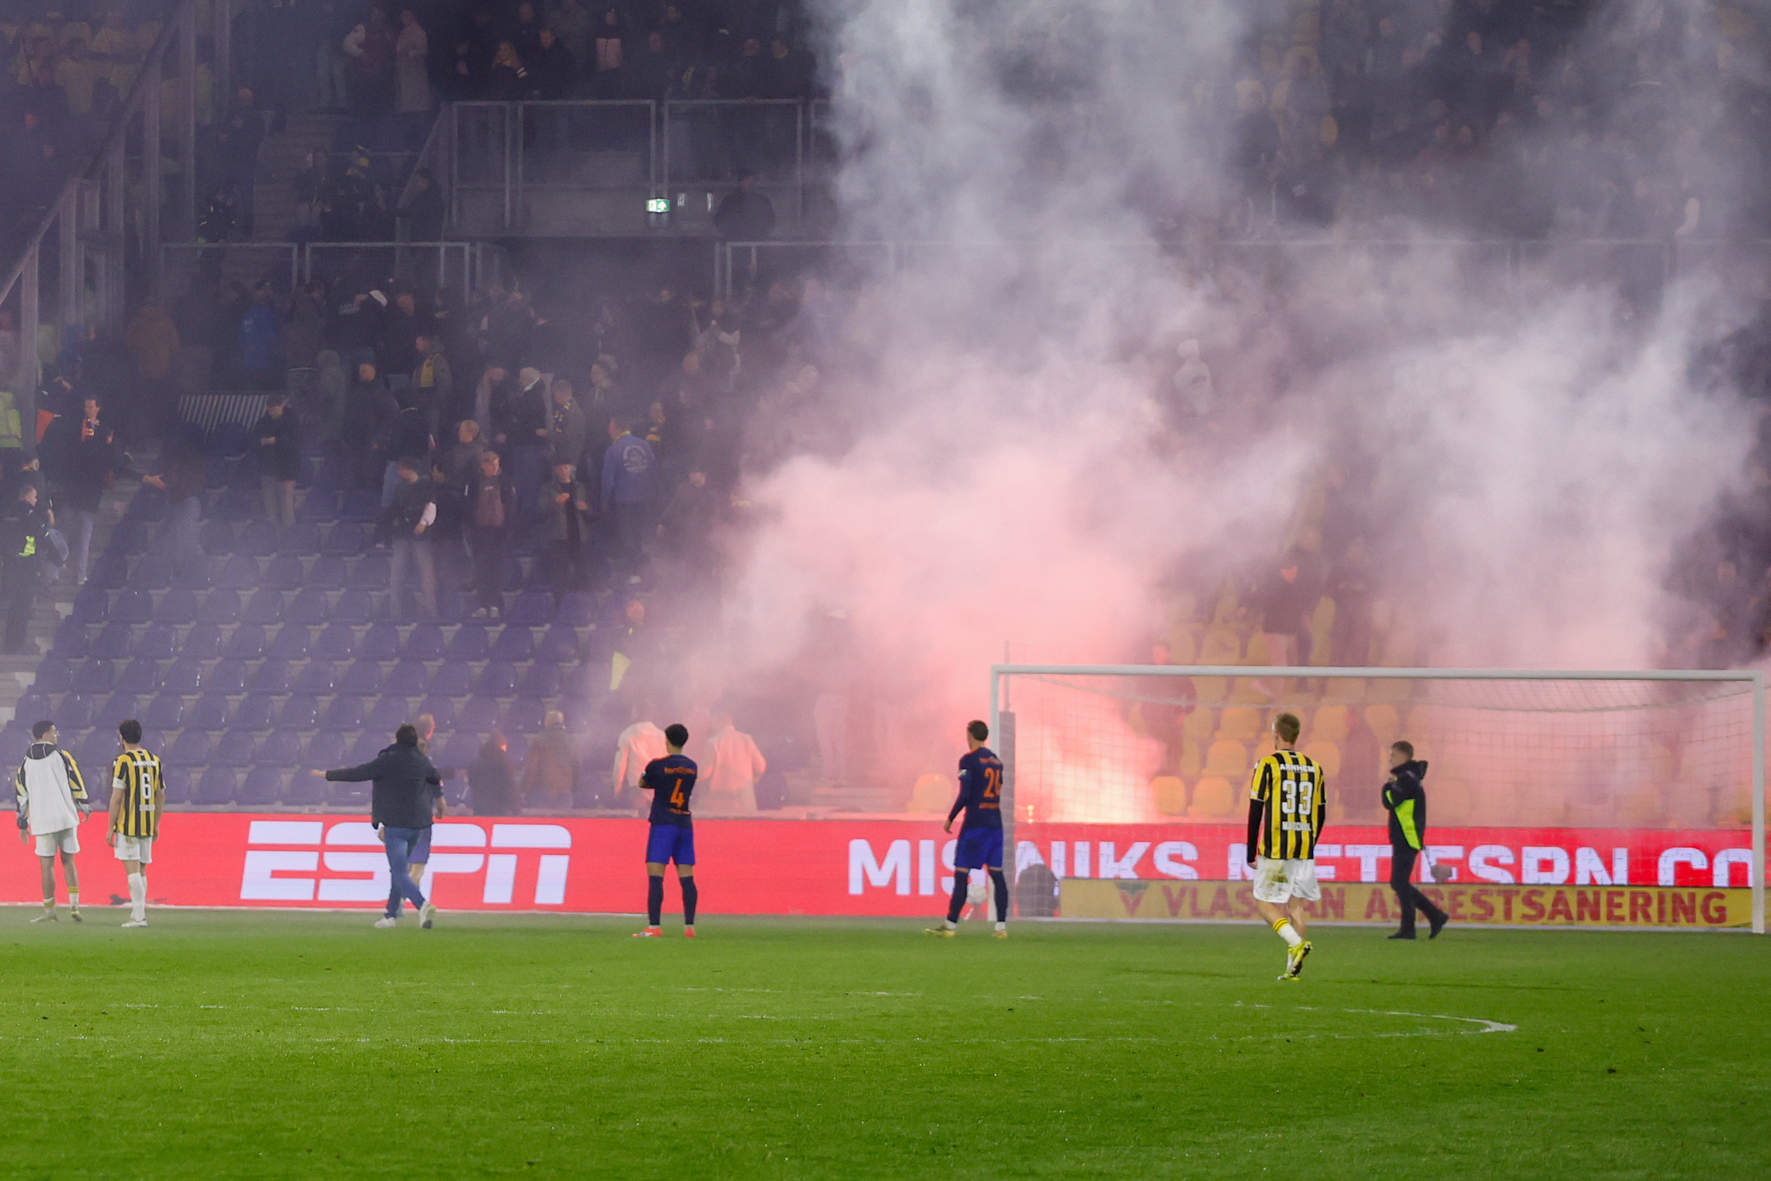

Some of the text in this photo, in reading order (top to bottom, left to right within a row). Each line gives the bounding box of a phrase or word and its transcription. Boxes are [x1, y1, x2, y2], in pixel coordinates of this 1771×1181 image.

[1280, 763, 1316, 773] ARNHEM
[141, 772, 152, 799] 6
[670, 778, 685, 808] 4
[1281, 779, 1313, 816] 33
[239, 820, 572, 904] ESPN
